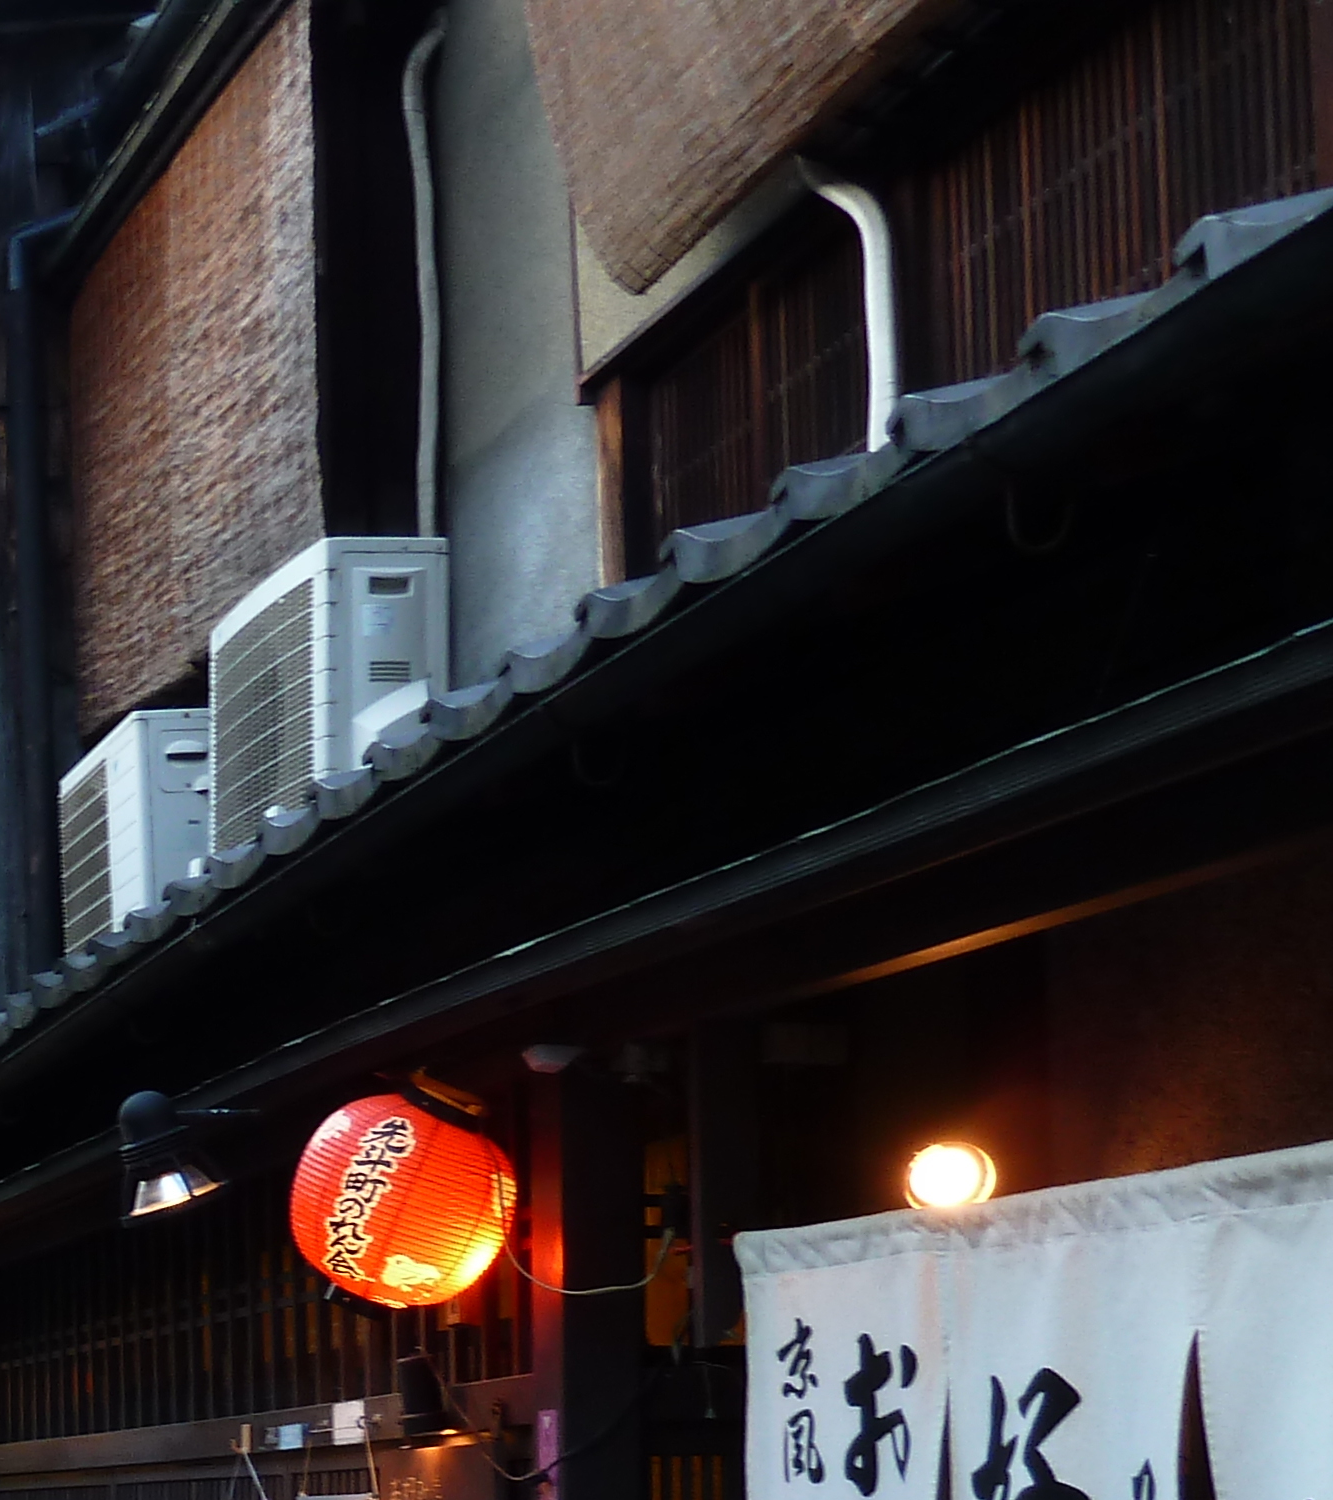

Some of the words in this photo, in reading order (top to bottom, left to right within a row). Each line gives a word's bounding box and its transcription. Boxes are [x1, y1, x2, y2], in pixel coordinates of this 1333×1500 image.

[323, 1117, 414, 1282] 先斗町のれん会
